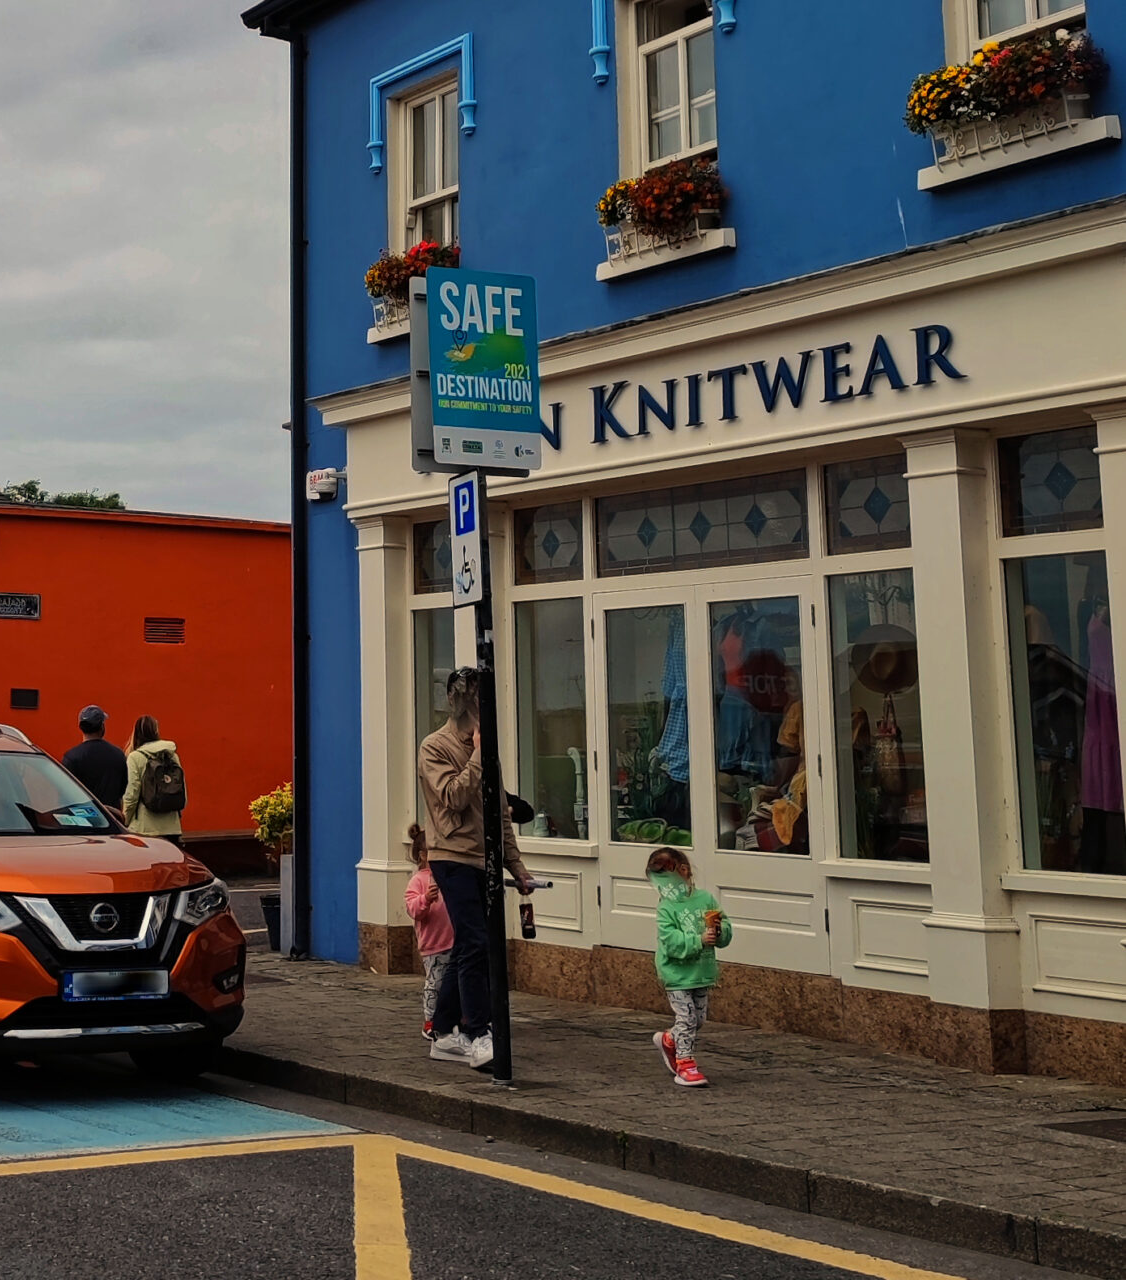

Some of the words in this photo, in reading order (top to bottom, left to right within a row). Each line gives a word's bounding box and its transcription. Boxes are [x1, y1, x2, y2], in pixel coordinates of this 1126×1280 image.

[439, 280, 525, 337] SAFE
[436, 372, 533, 403] DESTINATION
[504, 362, 531, 380] 2021
[588, 323, 969, 445] KNITWEAR
